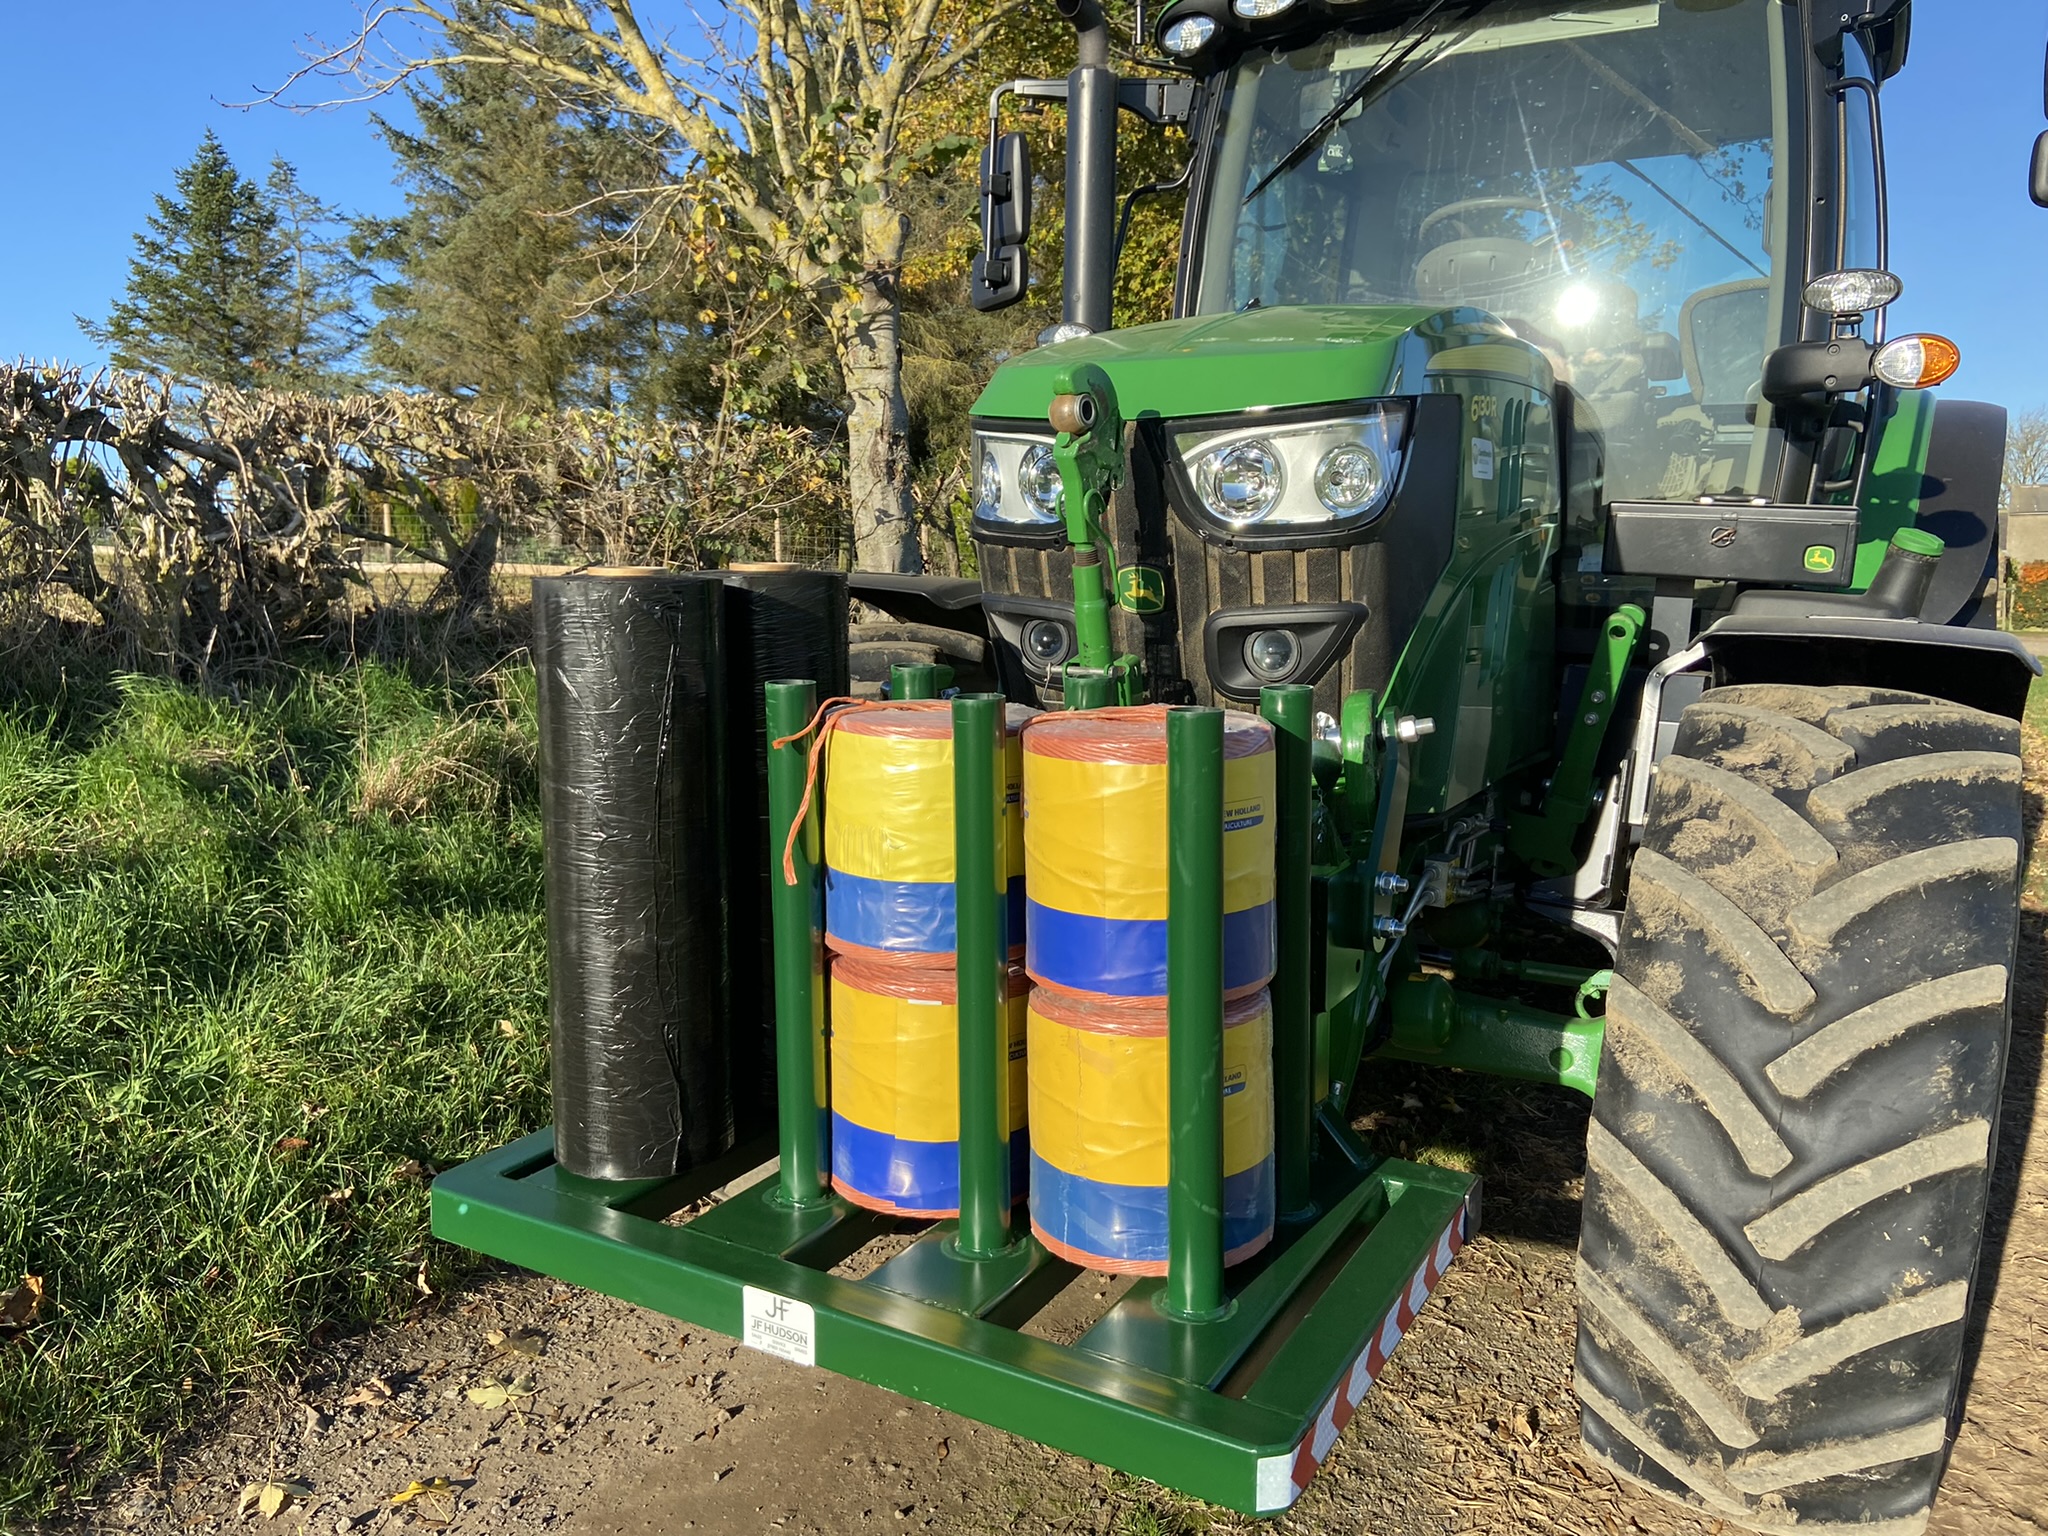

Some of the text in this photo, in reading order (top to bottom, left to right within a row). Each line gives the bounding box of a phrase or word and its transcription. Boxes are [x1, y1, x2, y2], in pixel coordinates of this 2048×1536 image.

[1471, 395, 1497, 422] 6130R
[1235, 803, 1261, 816] HOLLAND
[1224, 1071, 1241, 1082] LAND
[765, 1296, 793, 1321] JF
[752, 1319, 762, 1329] JF
[764, 1322, 808, 1346] HUDSON
